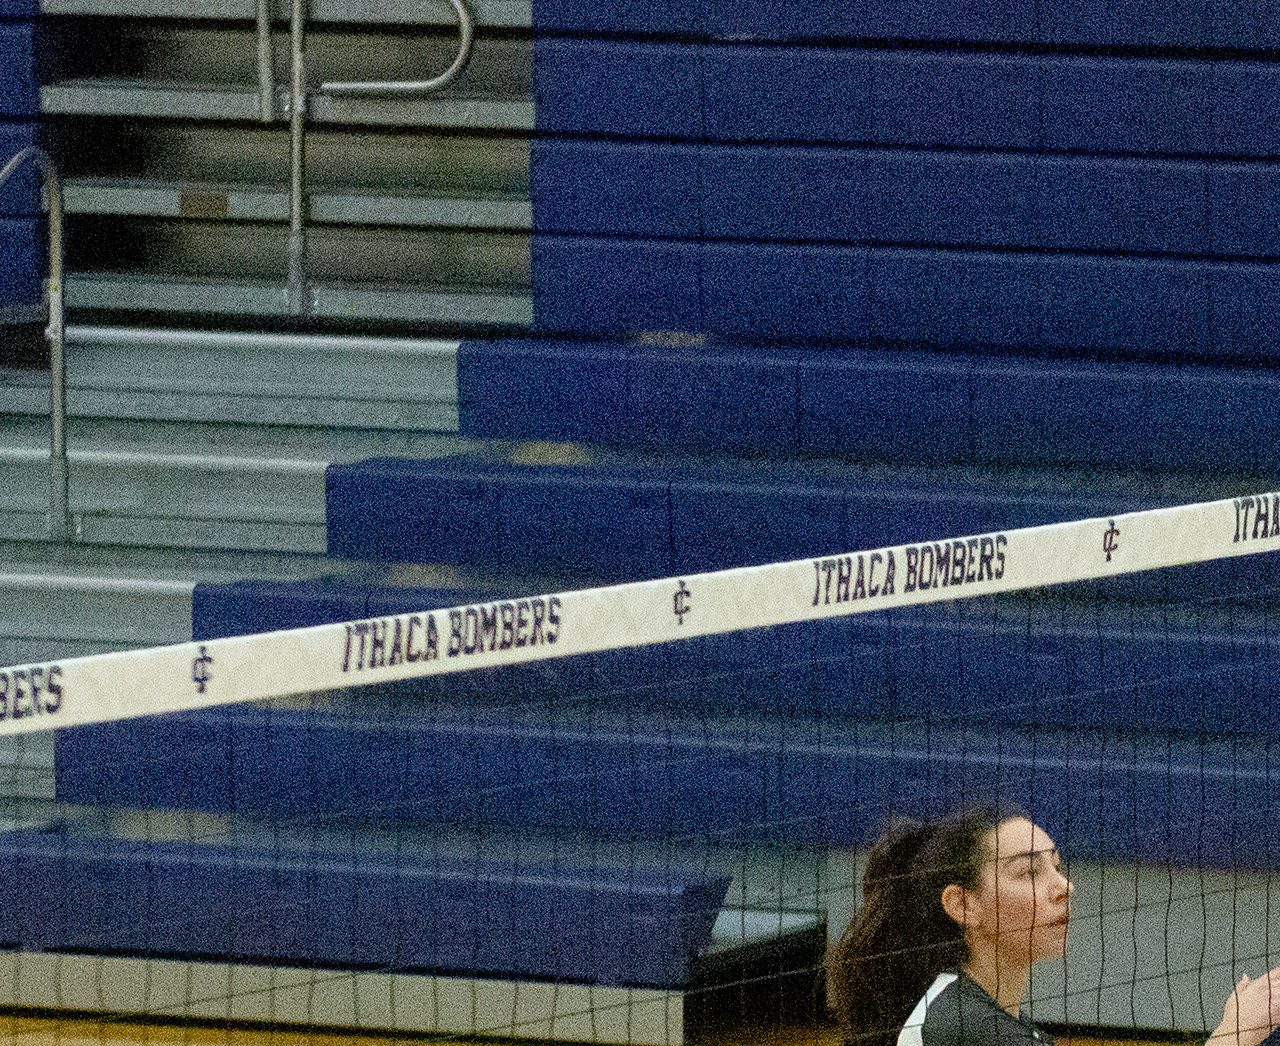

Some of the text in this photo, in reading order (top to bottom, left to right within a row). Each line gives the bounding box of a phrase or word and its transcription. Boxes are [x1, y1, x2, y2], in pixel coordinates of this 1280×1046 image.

[812, 535, 1008, 607] ITHACA BOMBERS
[342, 597, 562, 672] ITHACA BOMBERS
